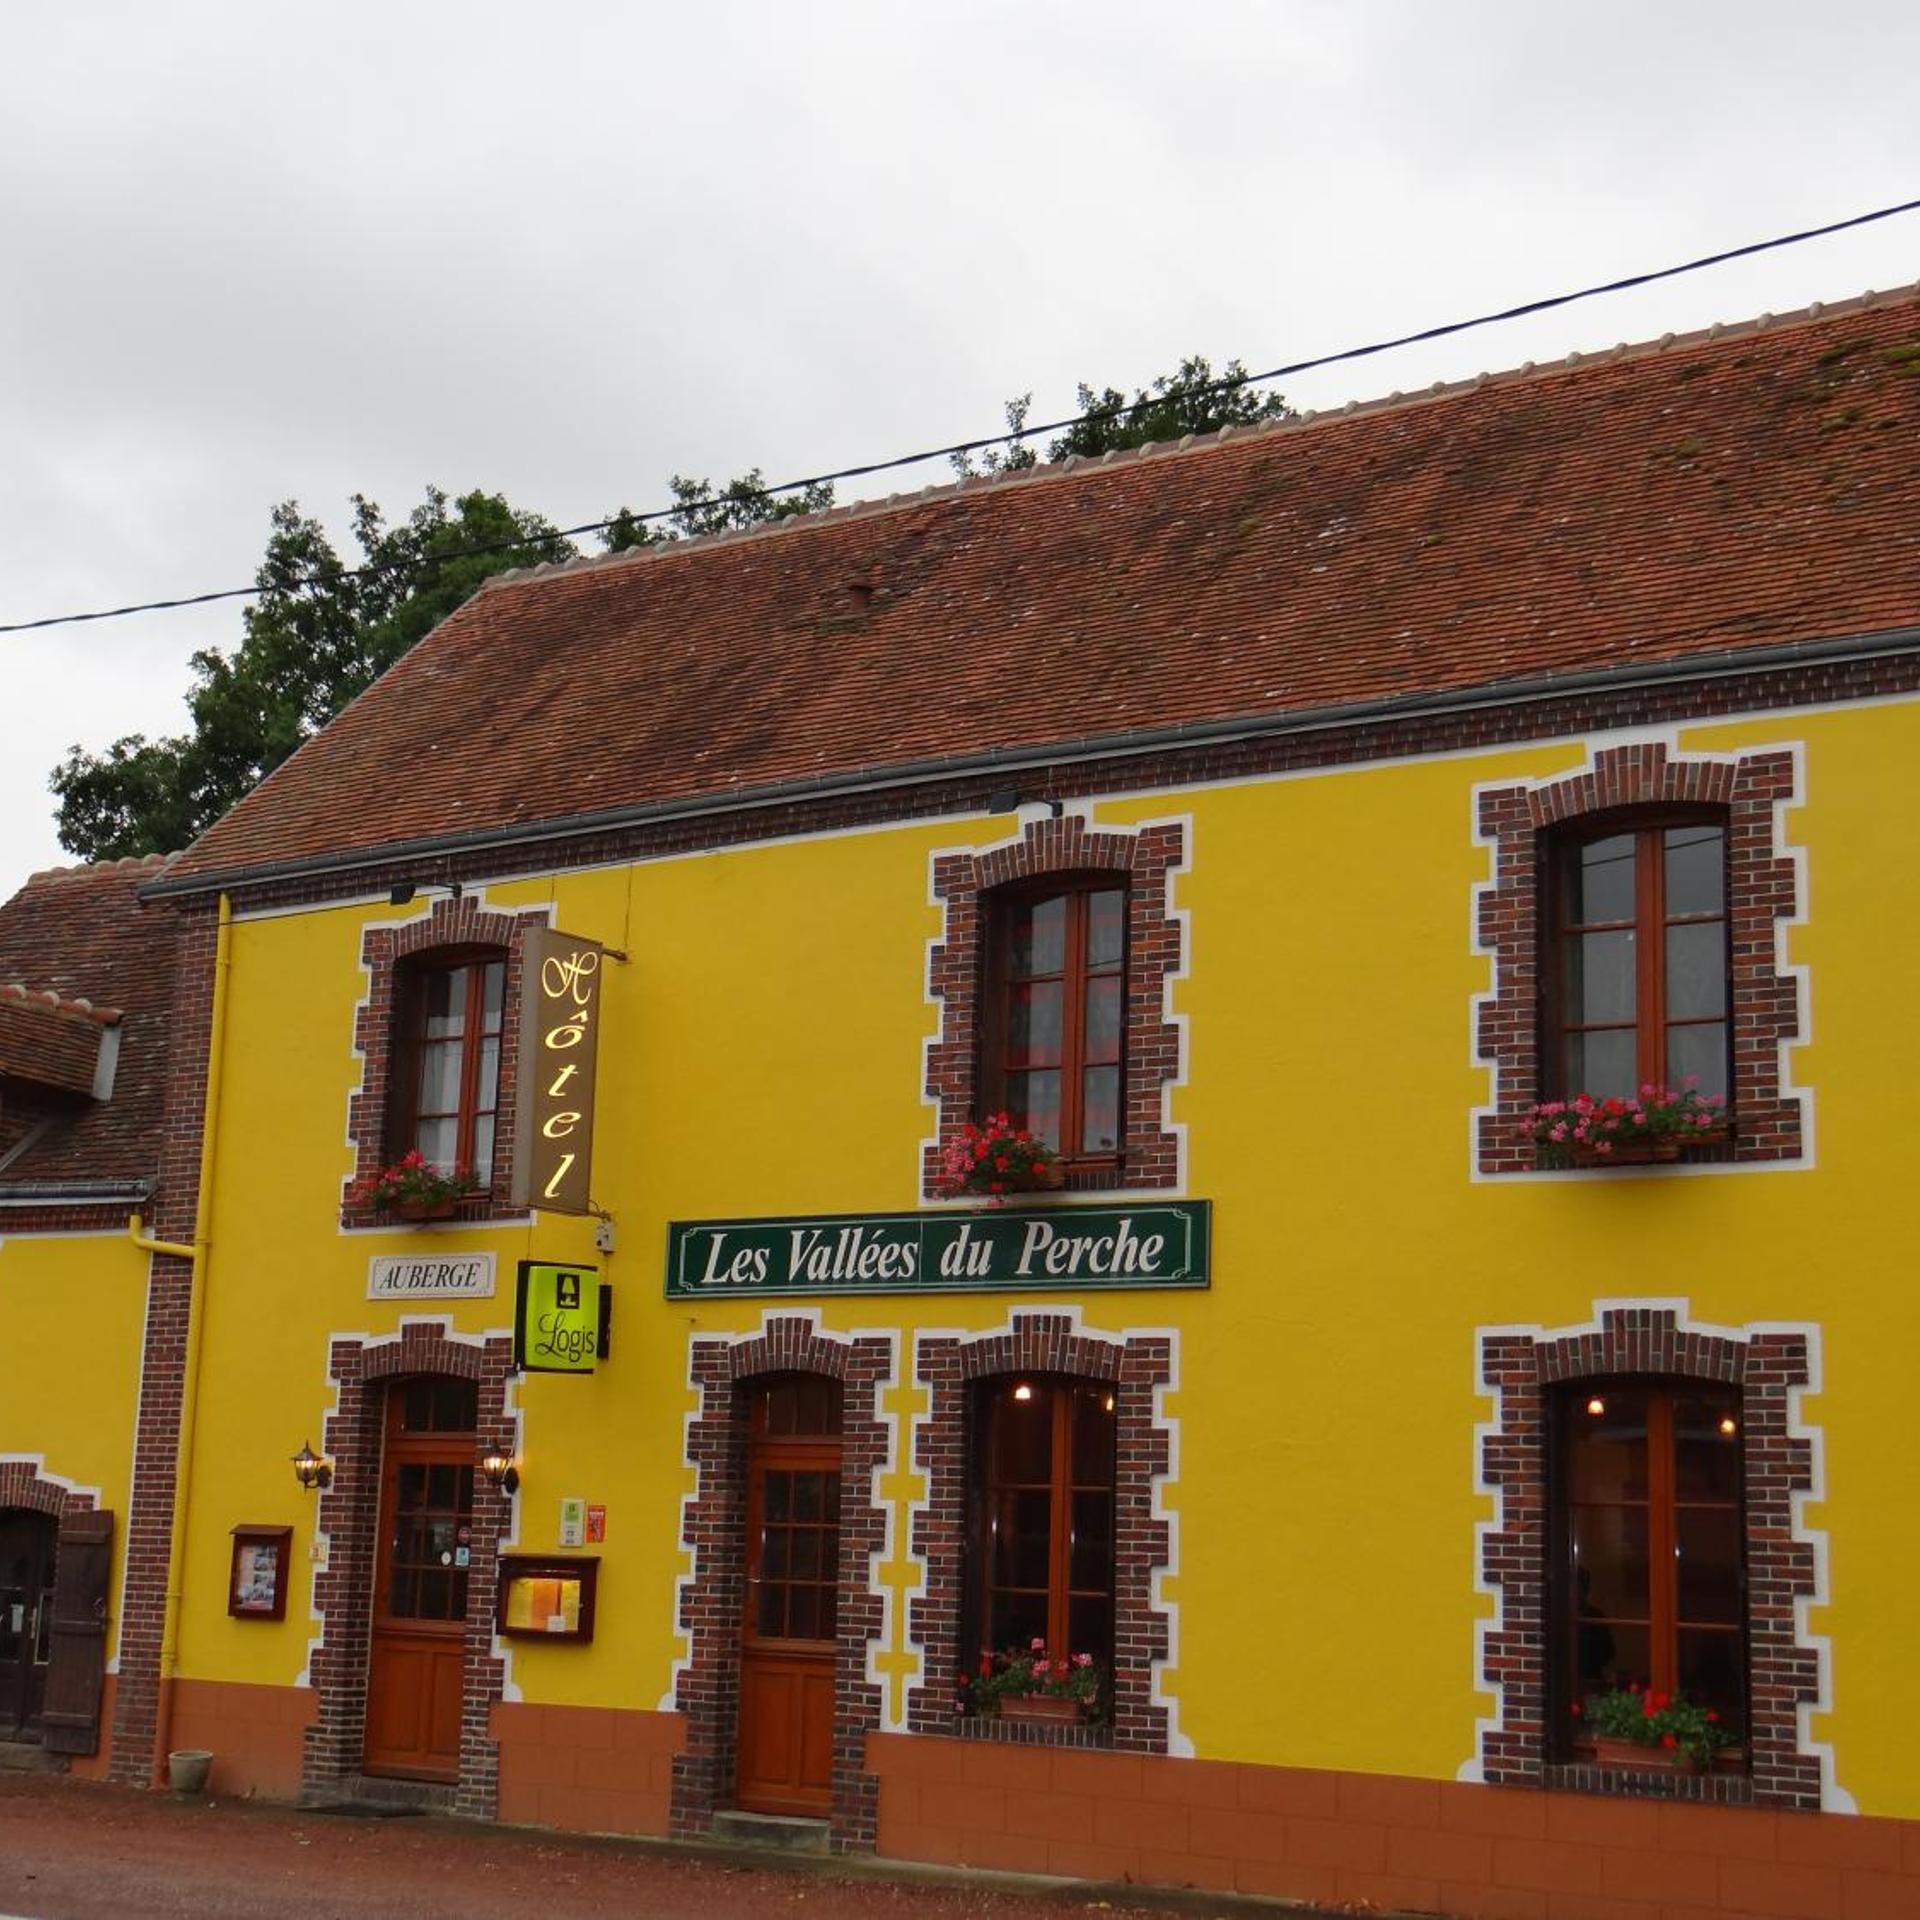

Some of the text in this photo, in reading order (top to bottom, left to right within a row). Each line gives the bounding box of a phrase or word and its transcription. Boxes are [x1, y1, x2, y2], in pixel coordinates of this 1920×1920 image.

[541, 951, 599, 1199] Hôtel
[379, 1262, 481, 1289] AUBERGE
[701, 1218, 1164, 1284] Les Vallées du Perche
[534, 1310, 595, 1363] Logis
